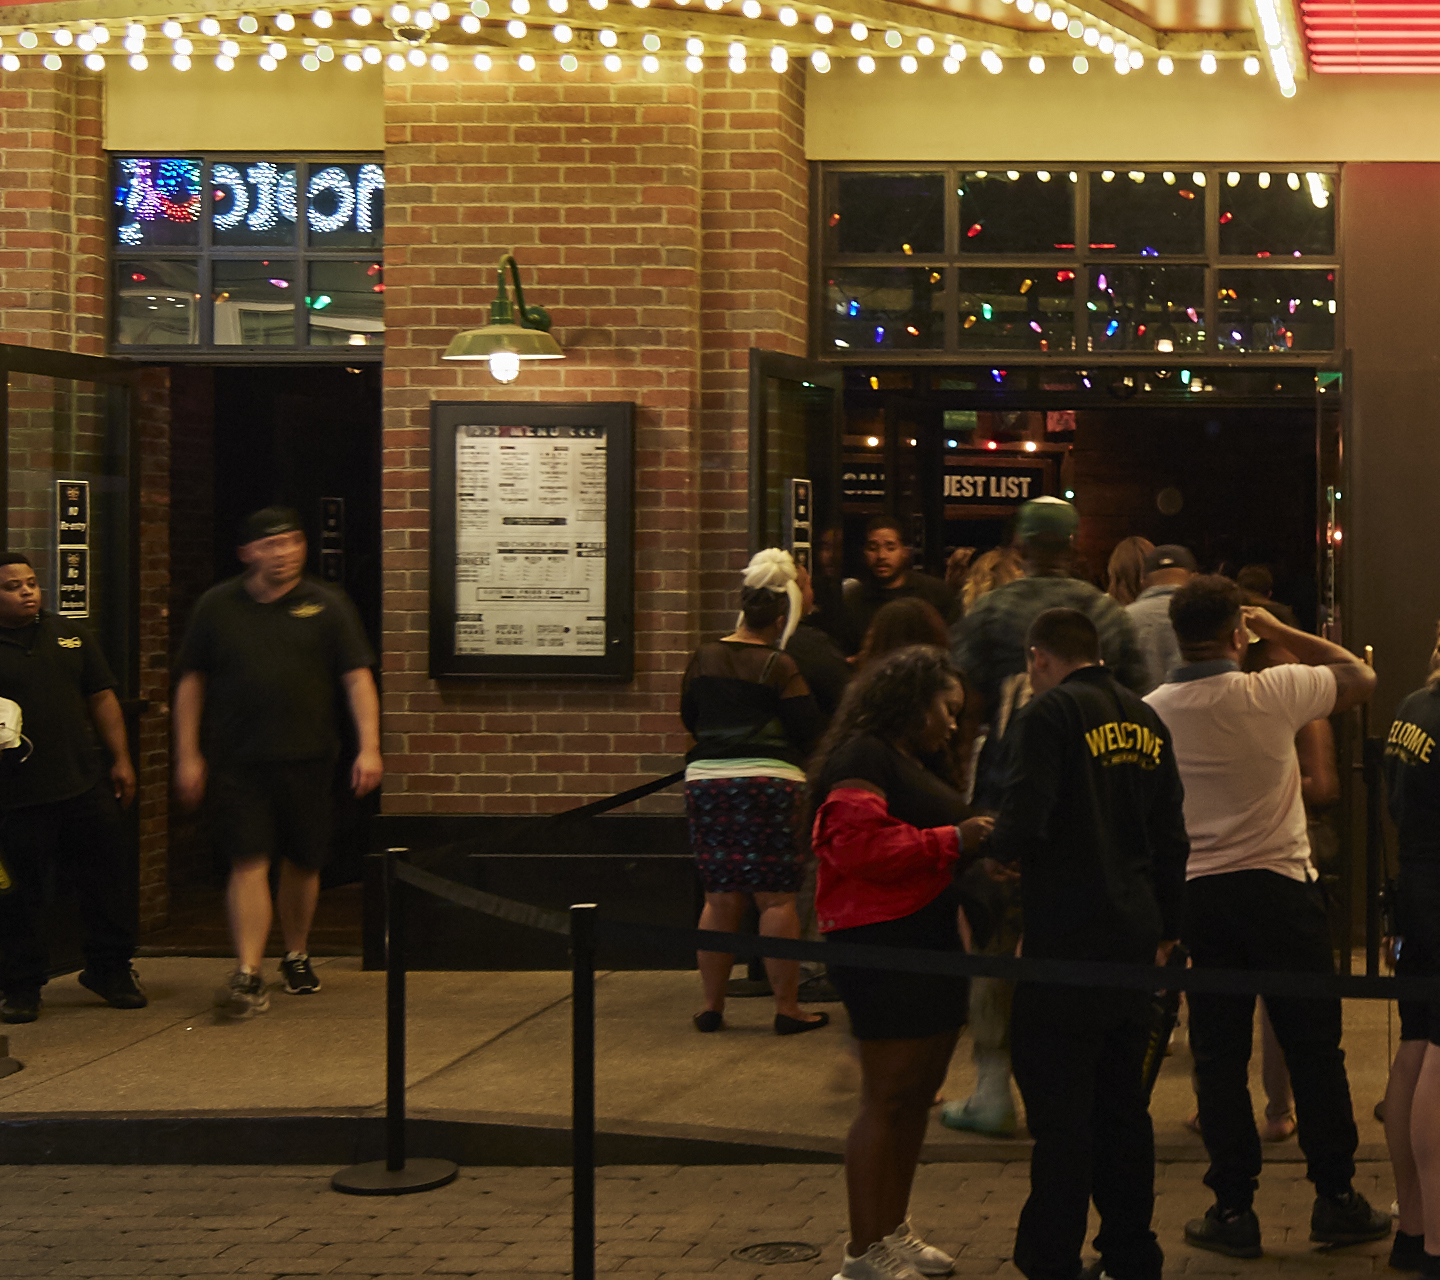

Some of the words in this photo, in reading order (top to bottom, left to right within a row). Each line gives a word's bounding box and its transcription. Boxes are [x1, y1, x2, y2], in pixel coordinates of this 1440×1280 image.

[943, 475, 987, 497] UEST
[990, 476, 1032, 498] LIST
[1388, 720, 1436, 764] ELCOME
